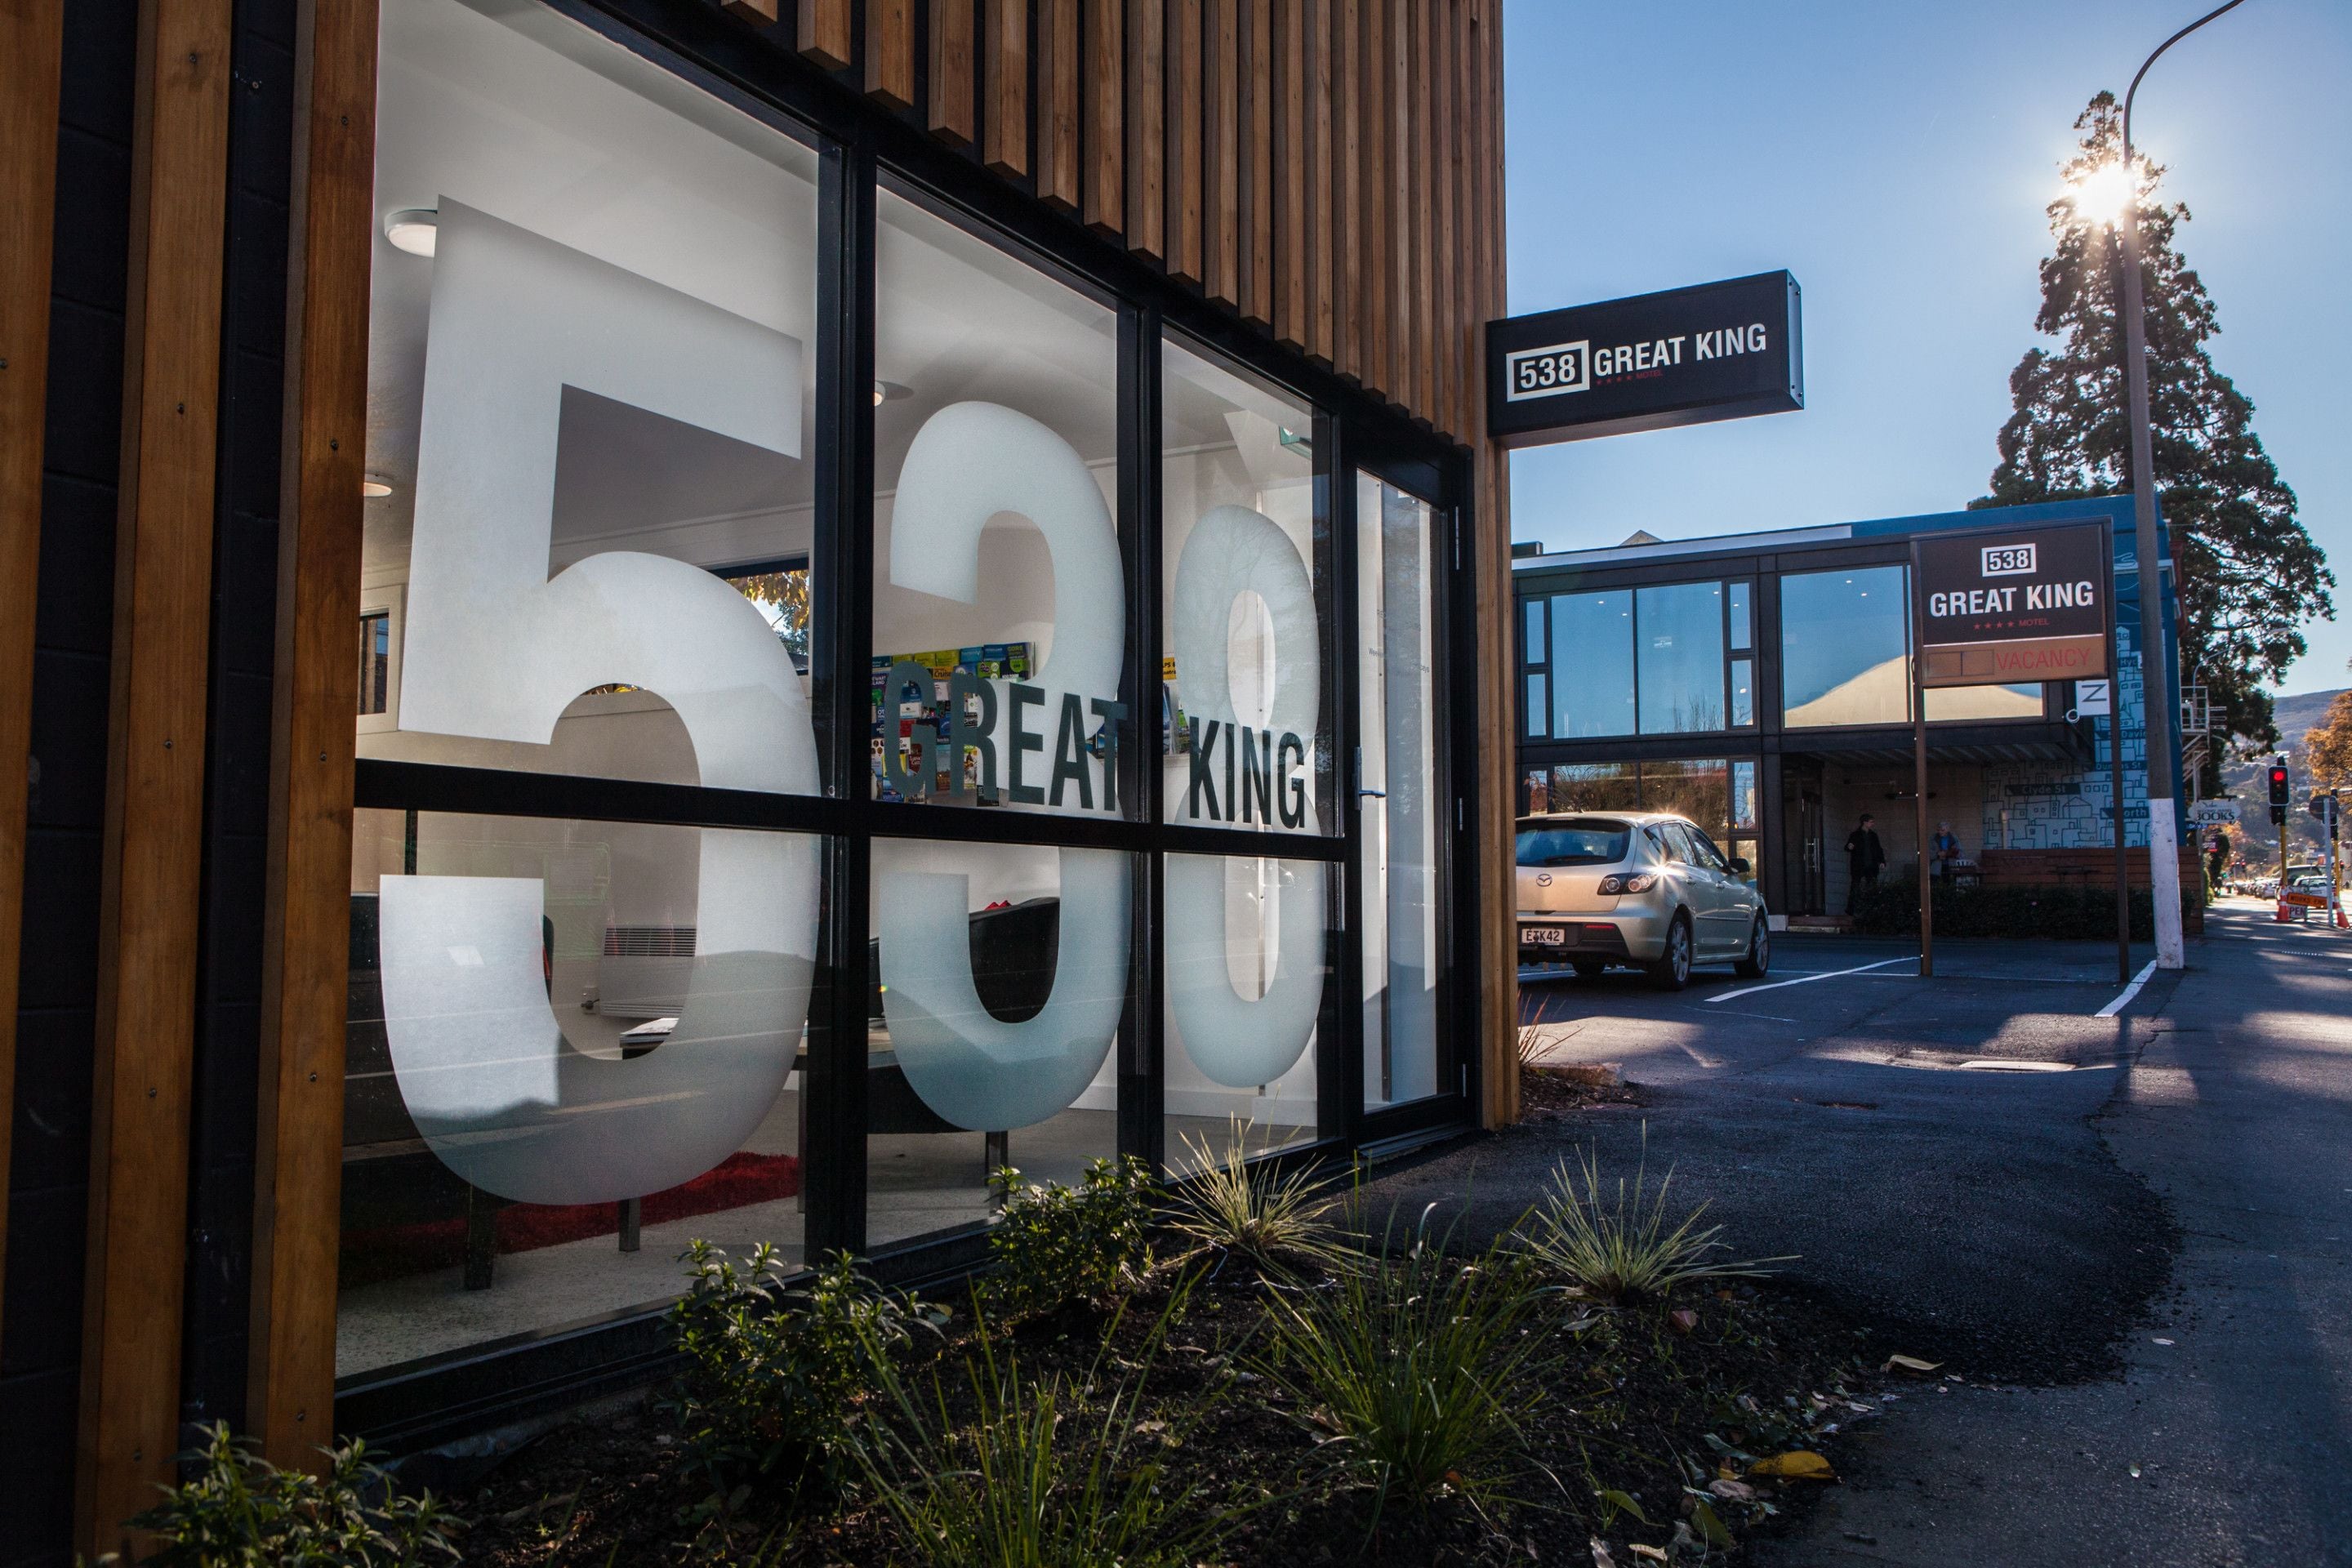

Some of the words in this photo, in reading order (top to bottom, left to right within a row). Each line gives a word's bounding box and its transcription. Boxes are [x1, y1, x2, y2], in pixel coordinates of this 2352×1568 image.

[1520, 354, 1576, 390] 538
[1594, 336, 1686, 376] GREAT
[1695, 323, 1767, 361] KING
[1636, 370, 1664, 380] MOTEL
[1989, 550, 2029, 571] 538
[1930, 587, 2016, 617] GREAT
[2027, 581, 2094, 610] KING
[2019, 617, 2050, 627] MOTEL
[1996, 648, 2091, 670] VACANCY
[884, 661, 1128, 812] GREAT
[1189, 716, 1305, 829] KING
[2022, 786, 2052, 795] Clyde
[2055, 785, 2066, 794] St
[2123, 808, 2147, 817] orth
[2289, 906, 2305, 915] PEN
